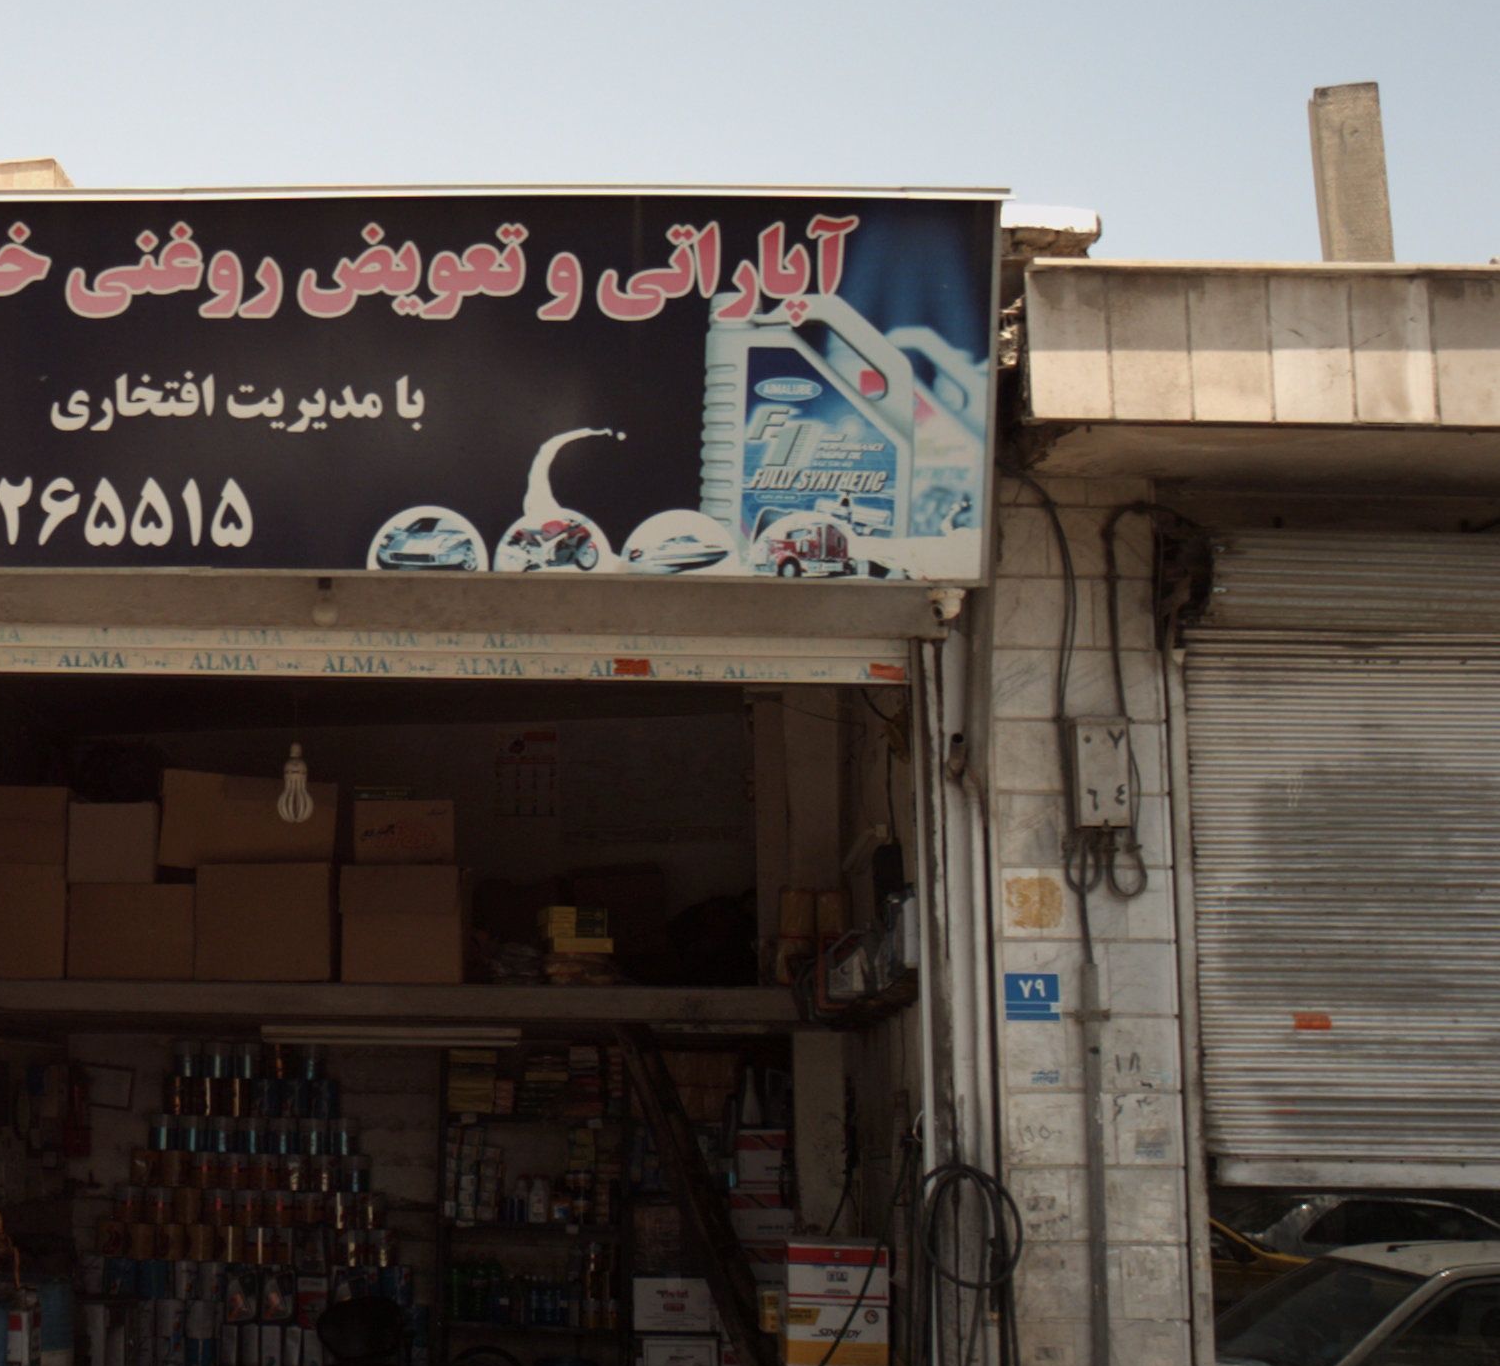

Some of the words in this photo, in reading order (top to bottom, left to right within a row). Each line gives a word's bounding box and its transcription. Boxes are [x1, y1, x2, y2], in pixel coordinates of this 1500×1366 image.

[65, 221, 283, 319] روغنی
[297, 222, 528, 320] تعویض
[537, 252, 582, 320] و
[597, 215, 860, 325] آپاراتی
[50, 371, 215, 432] افتخاری
[226, 383, 383, 433] مدیریت
[395, 375, 425, 431] با
[750, 468, 798, 491] FULLY
[798, 469, 887, 493] SYNTHETIC
[57, 650, 125, 669] ALMA
[189, 652, 257, 671] ALMA
[322, 652, 390, 674] ALMA
[455, 657, 524, 676] ALMA
[1017, 978, 1046, 999] ۷۹
